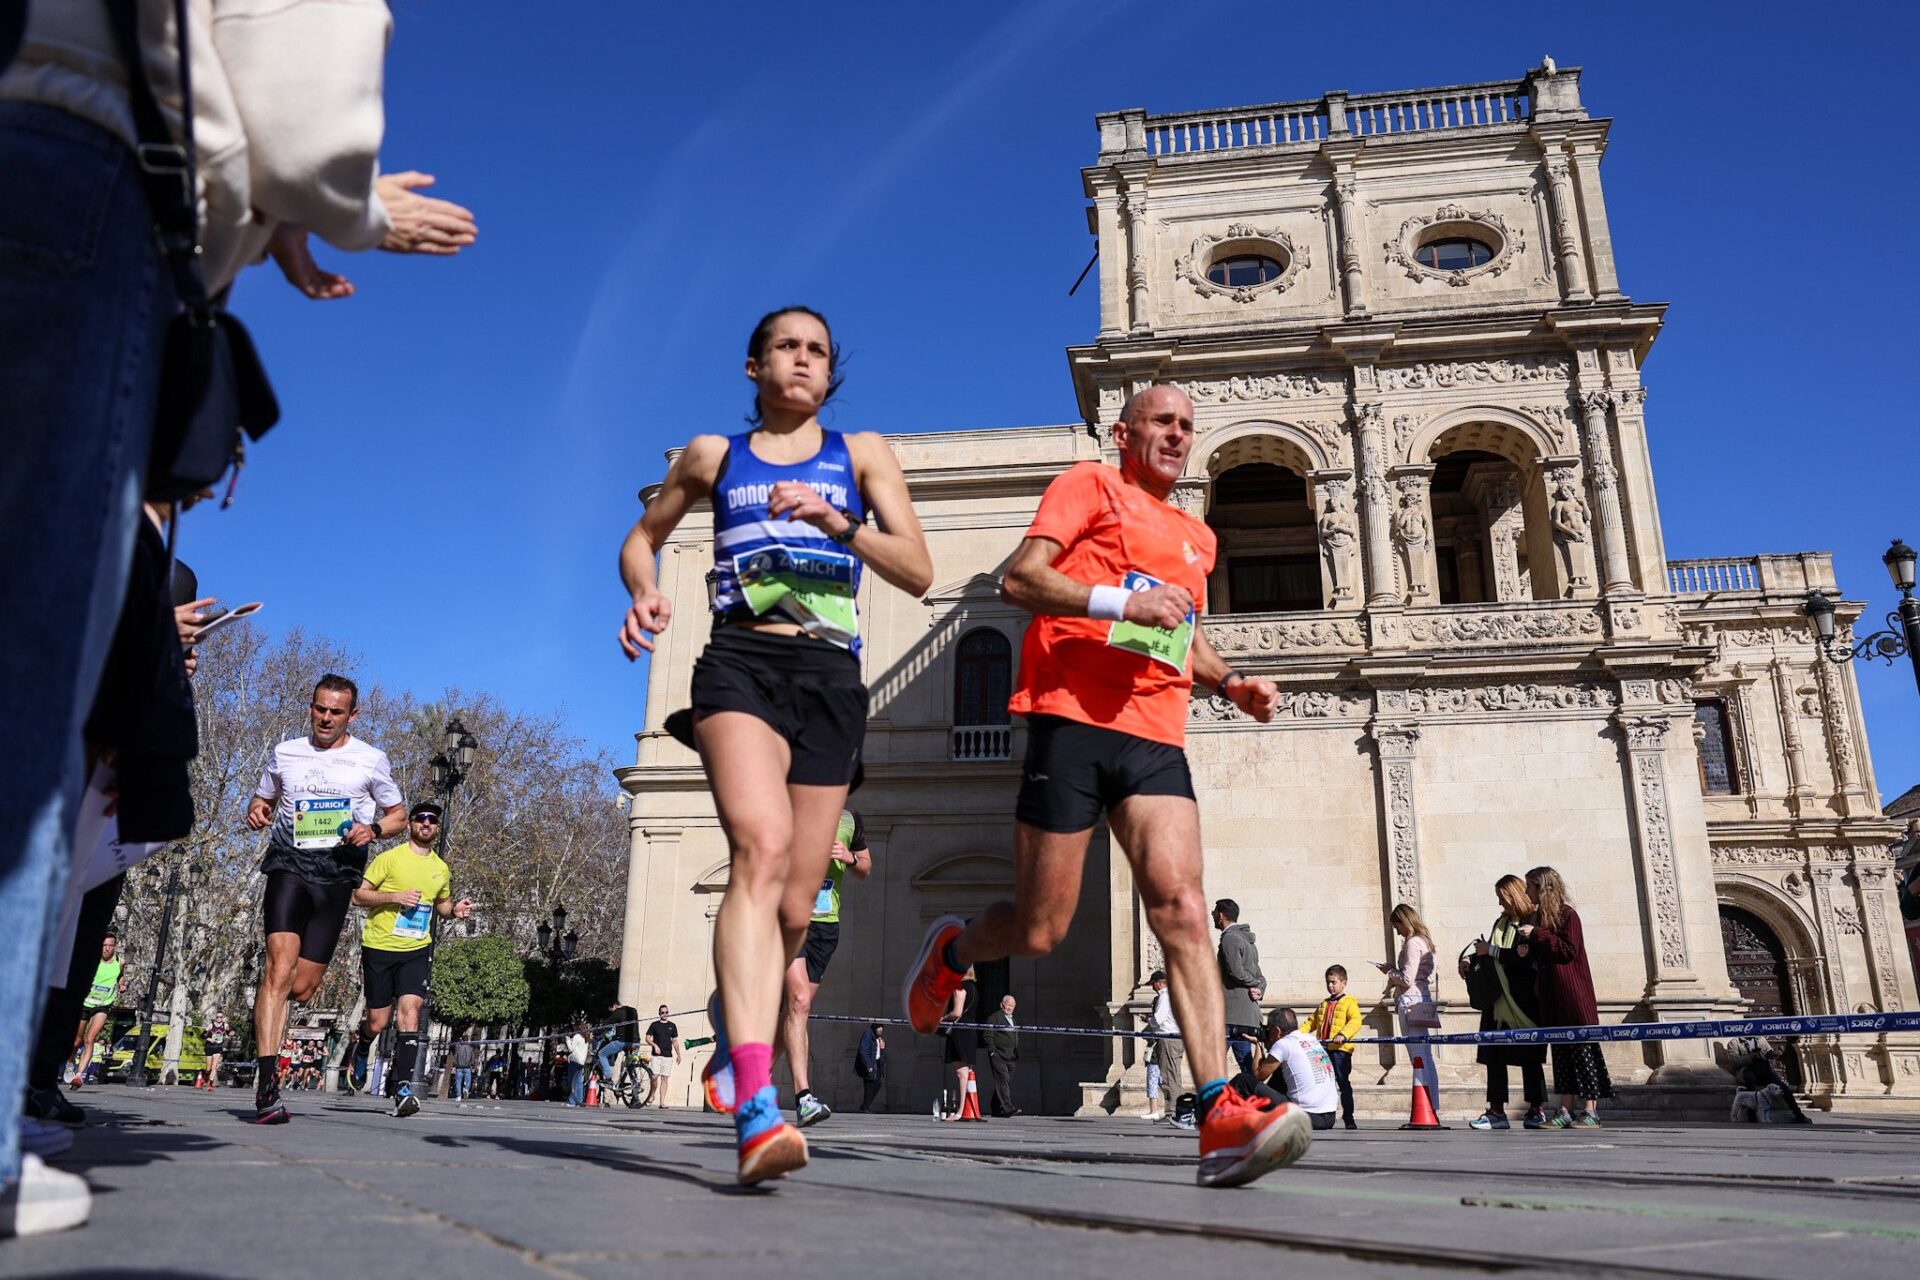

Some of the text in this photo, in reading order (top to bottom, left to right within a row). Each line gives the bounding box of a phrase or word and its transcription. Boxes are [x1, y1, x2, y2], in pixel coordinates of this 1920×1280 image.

[313, 801, 345, 809] ZURICH
[314, 817, 332, 825] 1442
[1851, 1019, 1874, 1028] asics
[1896, 1017, 1920, 1026] URICH
[1724, 1025, 1744, 1033] asics
[1762, 1023, 1790, 1031] ZURICH
